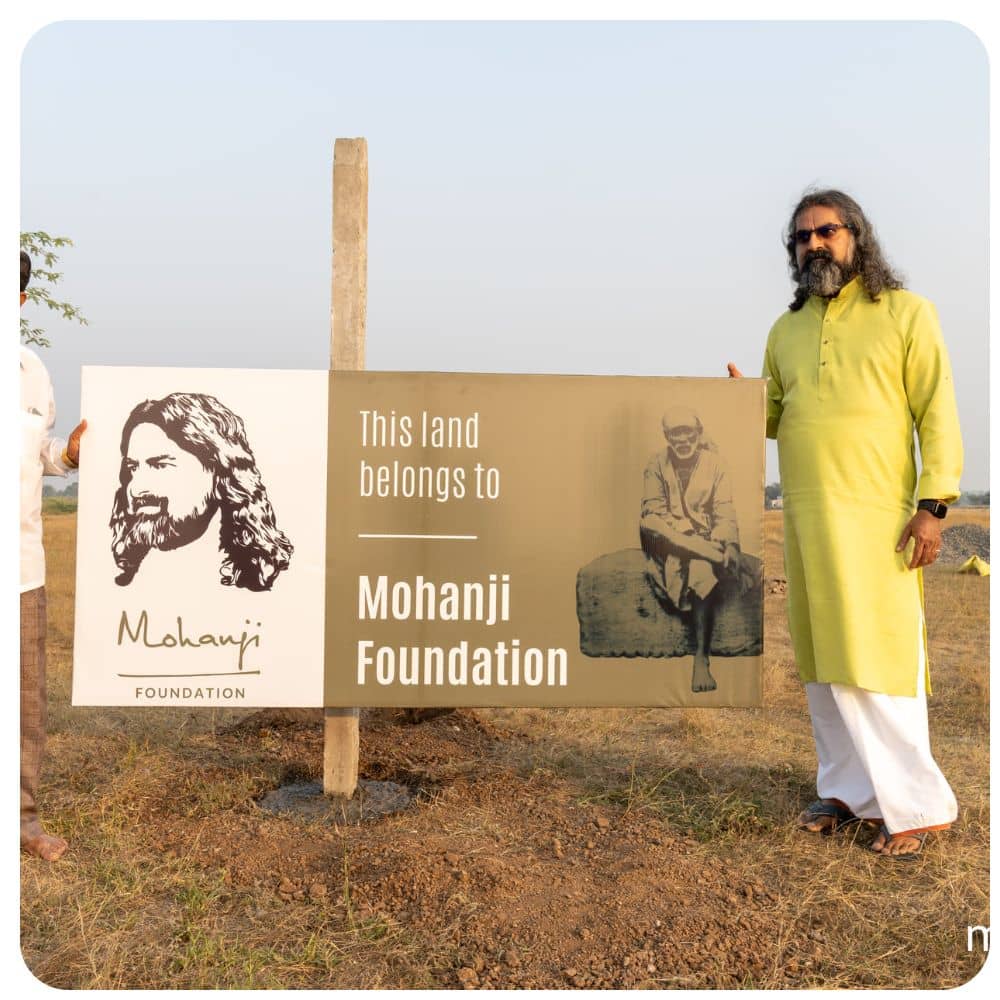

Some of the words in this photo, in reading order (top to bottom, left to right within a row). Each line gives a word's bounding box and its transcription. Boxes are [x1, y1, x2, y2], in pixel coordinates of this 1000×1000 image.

[359, 410, 413, 447] This
[422, 411, 479, 448] land
[360, 460, 466, 502] belongs
[474, 462, 500, 499] to
[358, 574, 510, 625] Mohanji
[117, 609, 262, 671] Mohanji
[357, 639, 568, 686] Foundation
[135, 687, 246, 699] FOUNDATION
